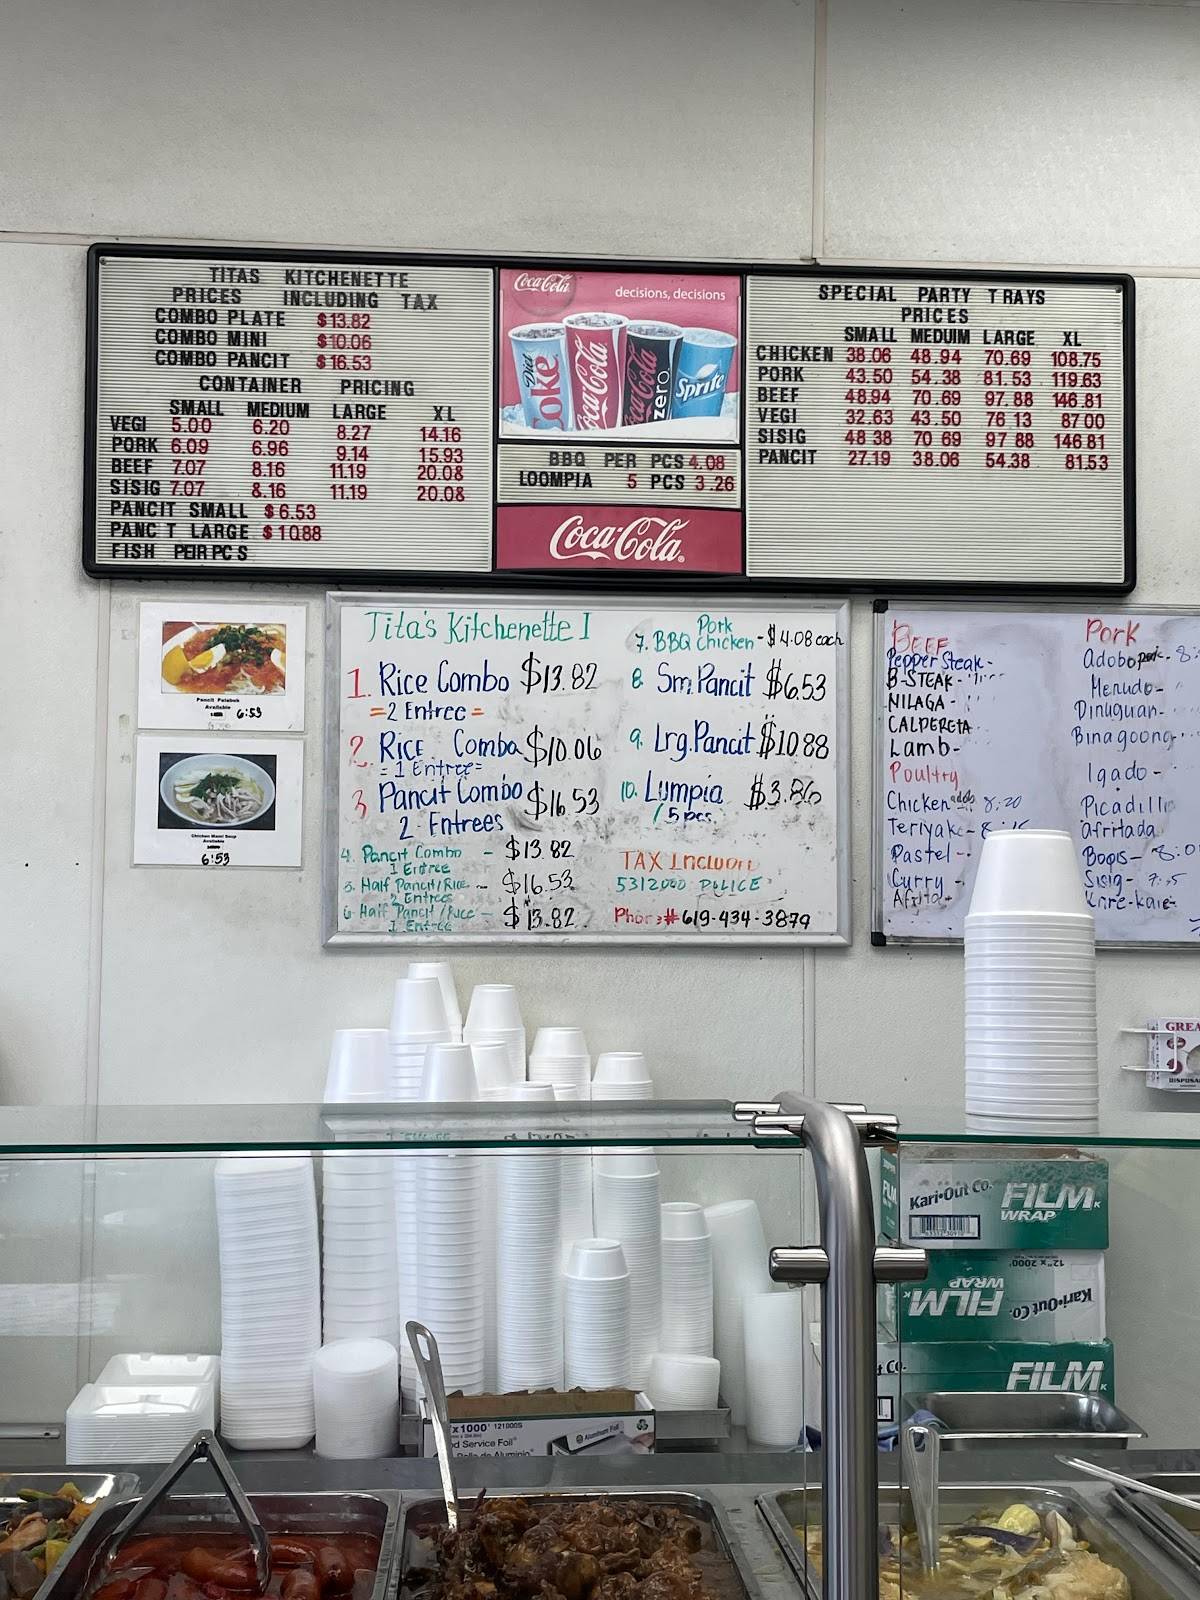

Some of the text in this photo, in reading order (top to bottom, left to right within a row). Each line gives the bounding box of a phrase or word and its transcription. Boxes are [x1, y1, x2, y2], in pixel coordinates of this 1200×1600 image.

[209, 267, 409, 288] TITAS KITCHENETTE
[514, 273, 573, 293] Coca-Cola
[173, 287, 438, 310] PRICES INCLUDING TAX
[615, 287, 725, 301] decisions, decisions
[819, 285, 897, 302] SPECIAL
[918, 288, 971, 304] PARTY
[155, 308, 371, 329] COMBO PLATE $13.82
[901, 308, 969, 324] PRICES
[155, 329, 372, 350] COMBO MINI $10.06
[844, 327, 1081, 346] SMALL MEDUIM LARGE XL
[155, 349, 372, 371] COMBO PANCIT $16.53
[756, 346, 1101, 367] CHICKEN 38.06 48.94 70.69 108.75
[522, 353, 536, 388] Diet
[758, 367, 1101, 388] PORK 43.50 54.38 81.53 119.63
[199, 375, 415, 396] CONTAINER PRICING
[653, 368, 670, 420] zero
[676, 372, 725, 402] Sprite
[758, 387, 1101, 408] BEEF 48.94 70.69 97.88 146.81
[169, 400, 455, 421] SMALL MEDIUM LARGE XL
[758, 408, 961, 426] VEGI 32.63 43.50
[110, 416, 461, 442] VEGI 5.00 6.20 8.27 14.16
[758, 429, 806, 444] SISIG
[112, 437, 463, 463] PORK 6.09 6.96 9.14 15.93
[759, 450, 1108, 470] PANCIT 27.19 38.06 54.38 81.53
[112, 458, 464, 481] BEEF 7.07 8.16 11.19 20.08
[550, 452, 724, 470] BBQ PER PCS 4.08
[110, 479, 465, 501] SISIG 7.07 8.16 11.19 20.08
[519, 471, 684, 489] LOOMPIA 5 PCS
[110, 500, 248, 518] PANCIT SMALL
[191, 524, 249, 539] LARGE
[550, 516, 689, 562] Coca-Cola
[112, 544, 155, 559] FISH
[365, 611, 571, 644] Tita's Kitchenette
[697, 614, 732, 634] Pork
[1086, 619, 1140, 646] Pork
[635, 633, 649, 652] 7.
[653, 630, 691, 653] BBQ
[887, 648, 938, 674] Pepper
[347, 651, 598, 699] 1. Rice Combo $13.82
[698, 663, 755, 697] Pancit
[763, 659, 827, 701] $6.53
[237, 707, 262, 719] 6:53
[405, 701, 467, 721] Entree
[524, 725, 601, 768] $10.06
[630, 714, 829, 760] 9. Pancit $10.88
[890, 761, 959, 790] Poultry
[379, 778, 599, 820] Pancit Combo $16.53
[645, 770, 723, 811] Lumpia
[400, 812, 503, 840] 2 Entrees
[202, 853, 230, 866] 6:53
[362, 835, 575, 863] Pancit $13.82
[891, 843, 950, 864] Pastel
[623, 851, 664, 872] TAX
[361, 869, 575, 894] Half $16.53
[890, 868, 943, 897] Curry
[503, 897, 575, 930] $13.82
[682, 909, 811, 929] 619-434-3879
[1000, 1182, 1096, 1210] FILM
[1000, 1211, 1056, 1222] WRAP
[948, 1276, 1004, 1288] WRAP
[908, 1290, 1005, 1317] FILM
[1006, 1361, 1104, 1392] FILM
[462, 1440, 495, 1448] Service
